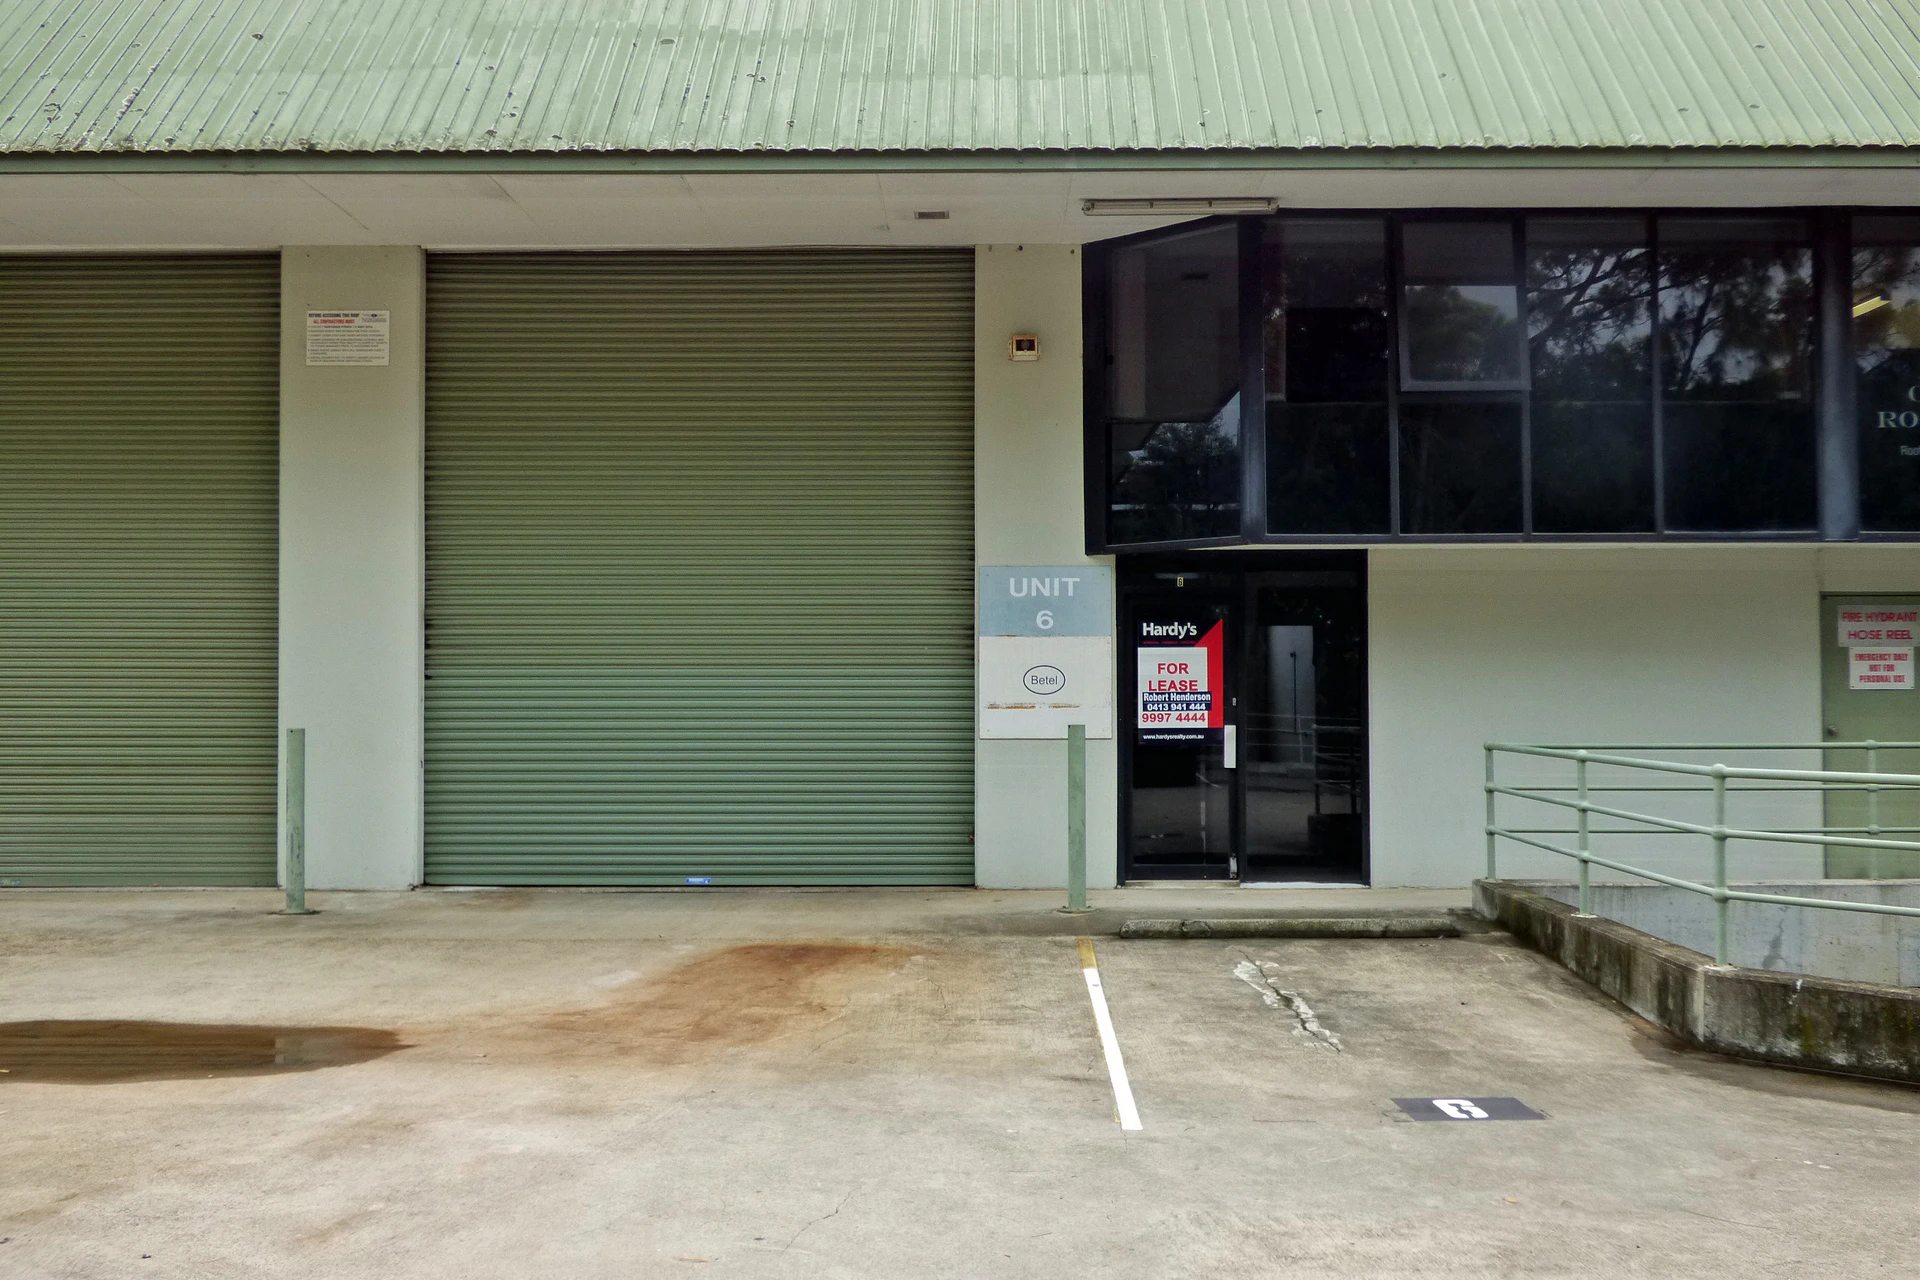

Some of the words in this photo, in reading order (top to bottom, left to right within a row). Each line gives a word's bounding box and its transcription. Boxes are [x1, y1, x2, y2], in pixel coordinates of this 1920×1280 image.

[1009, 577, 1081, 598] UNIT
[1035, 610, 1054, 630] 6
[1842, 611, 1862, 622] FIRE
[1865, 611, 1918, 622] HYDRANT
[1142, 622, 1198, 639] Hardy's
[1847, 629, 1882, 640] HOSE
[1886, 629, 1913, 640] REEL
[1855, 653, 1891, 661] EMERGENCY
[1893, 653, 1908, 661] ONLY
[1157, 663, 1190, 675] FOR
[1869, 664, 1881, 672] NOT
[1883, 664, 1896, 672] FOR
[1031, 675, 1058, 685] Betel
[1859, 675, 1892, 683] PERSONAL
[1893, 675, 1905, 683] USE
[1148, 680, 1199, 692] LEASE
[1143, 692, 1169, 702] Robert
[1170, 692, 1211, 702] Henderson
[1147, 703, 1169, 711] 0413
[1170, 703, 1187, 711] 941
[1189, 703, 1206, 711] 444
[1141, 713, 1172, 723] 9997
[1175, 713, 1206, 723] 4444
[1432, 1099, 1490, 1119] 6
